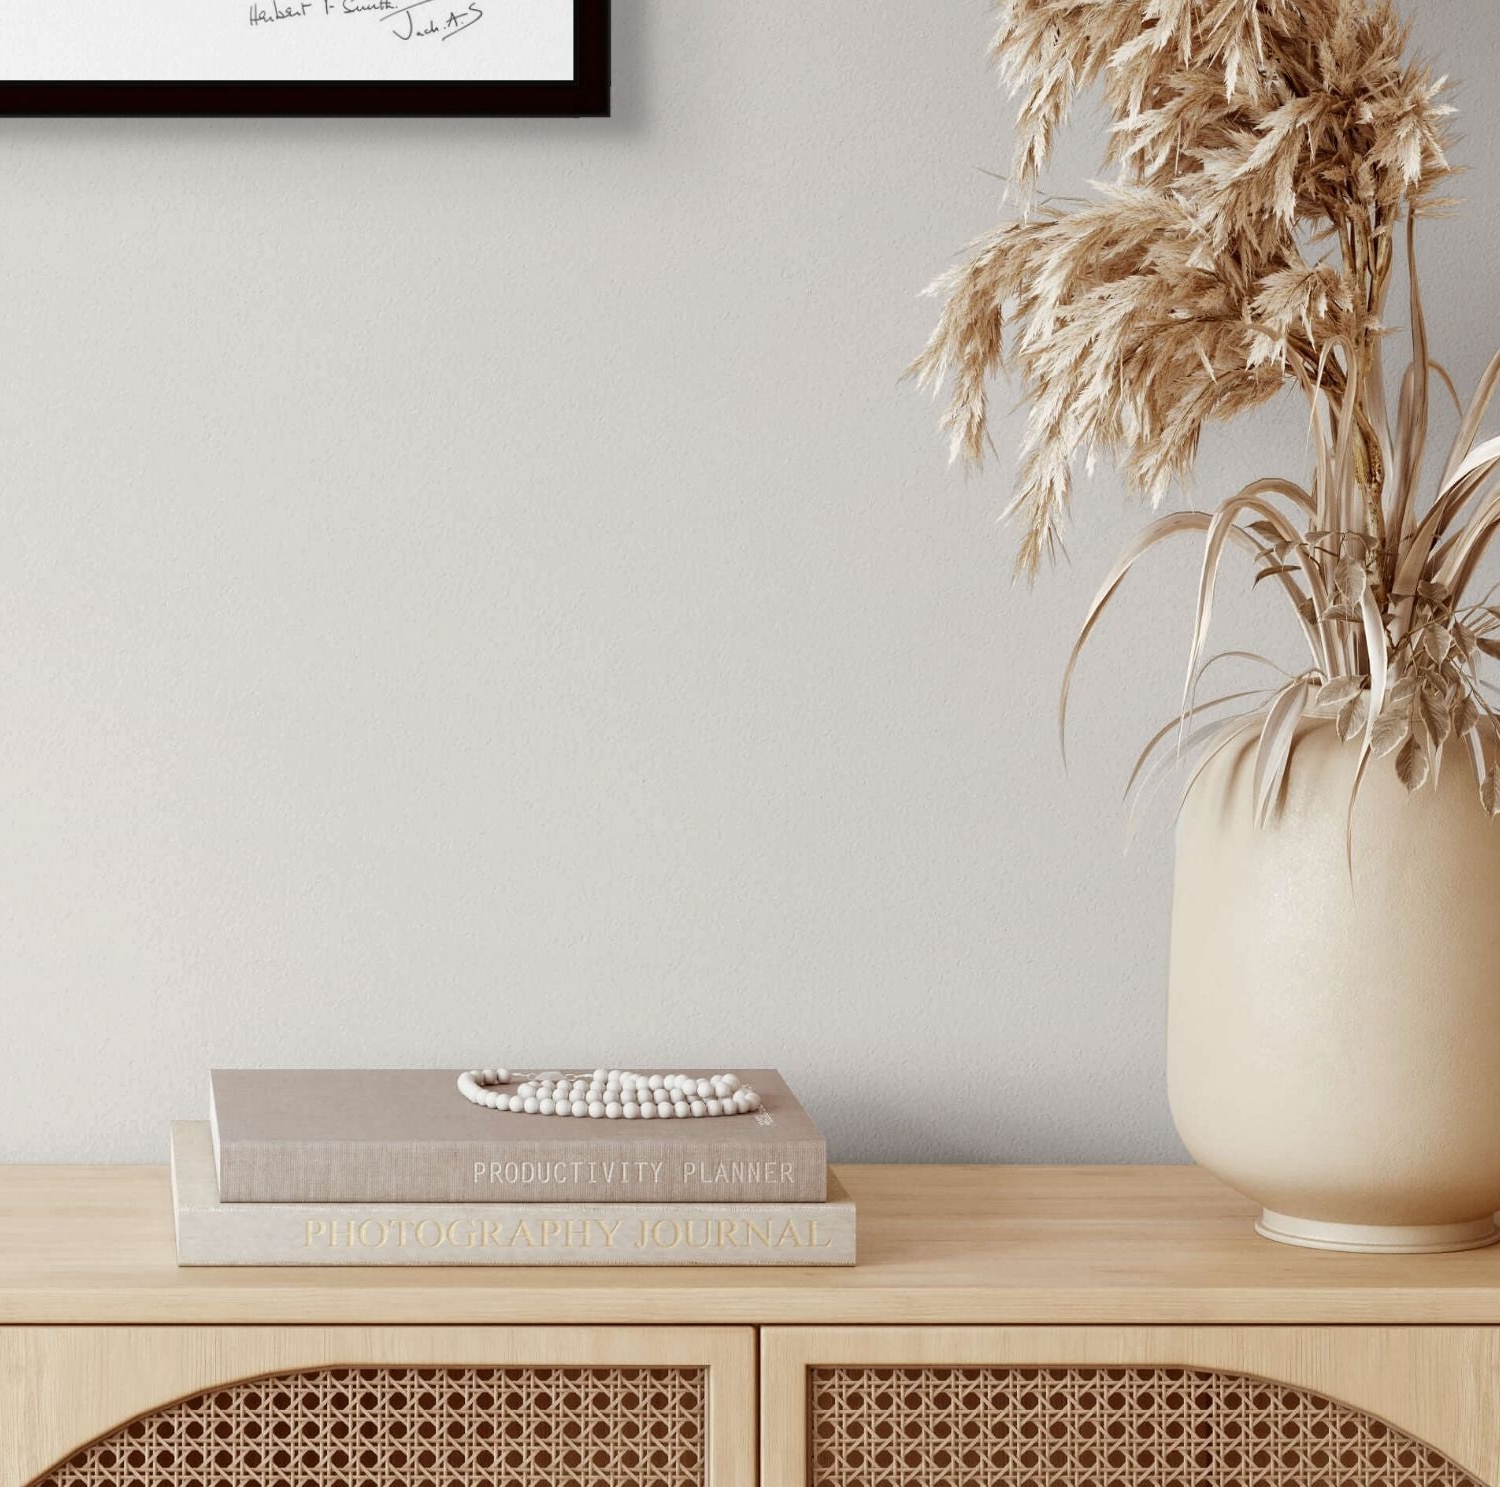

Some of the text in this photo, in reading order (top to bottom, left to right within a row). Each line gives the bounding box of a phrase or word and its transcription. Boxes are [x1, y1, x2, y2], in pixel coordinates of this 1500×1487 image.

[472, 1160, 796, 1184] PRODUCTIVITY PLANNER
[303, 1218, 833, 1249] PHOTOGRAPHY JOURNAL
